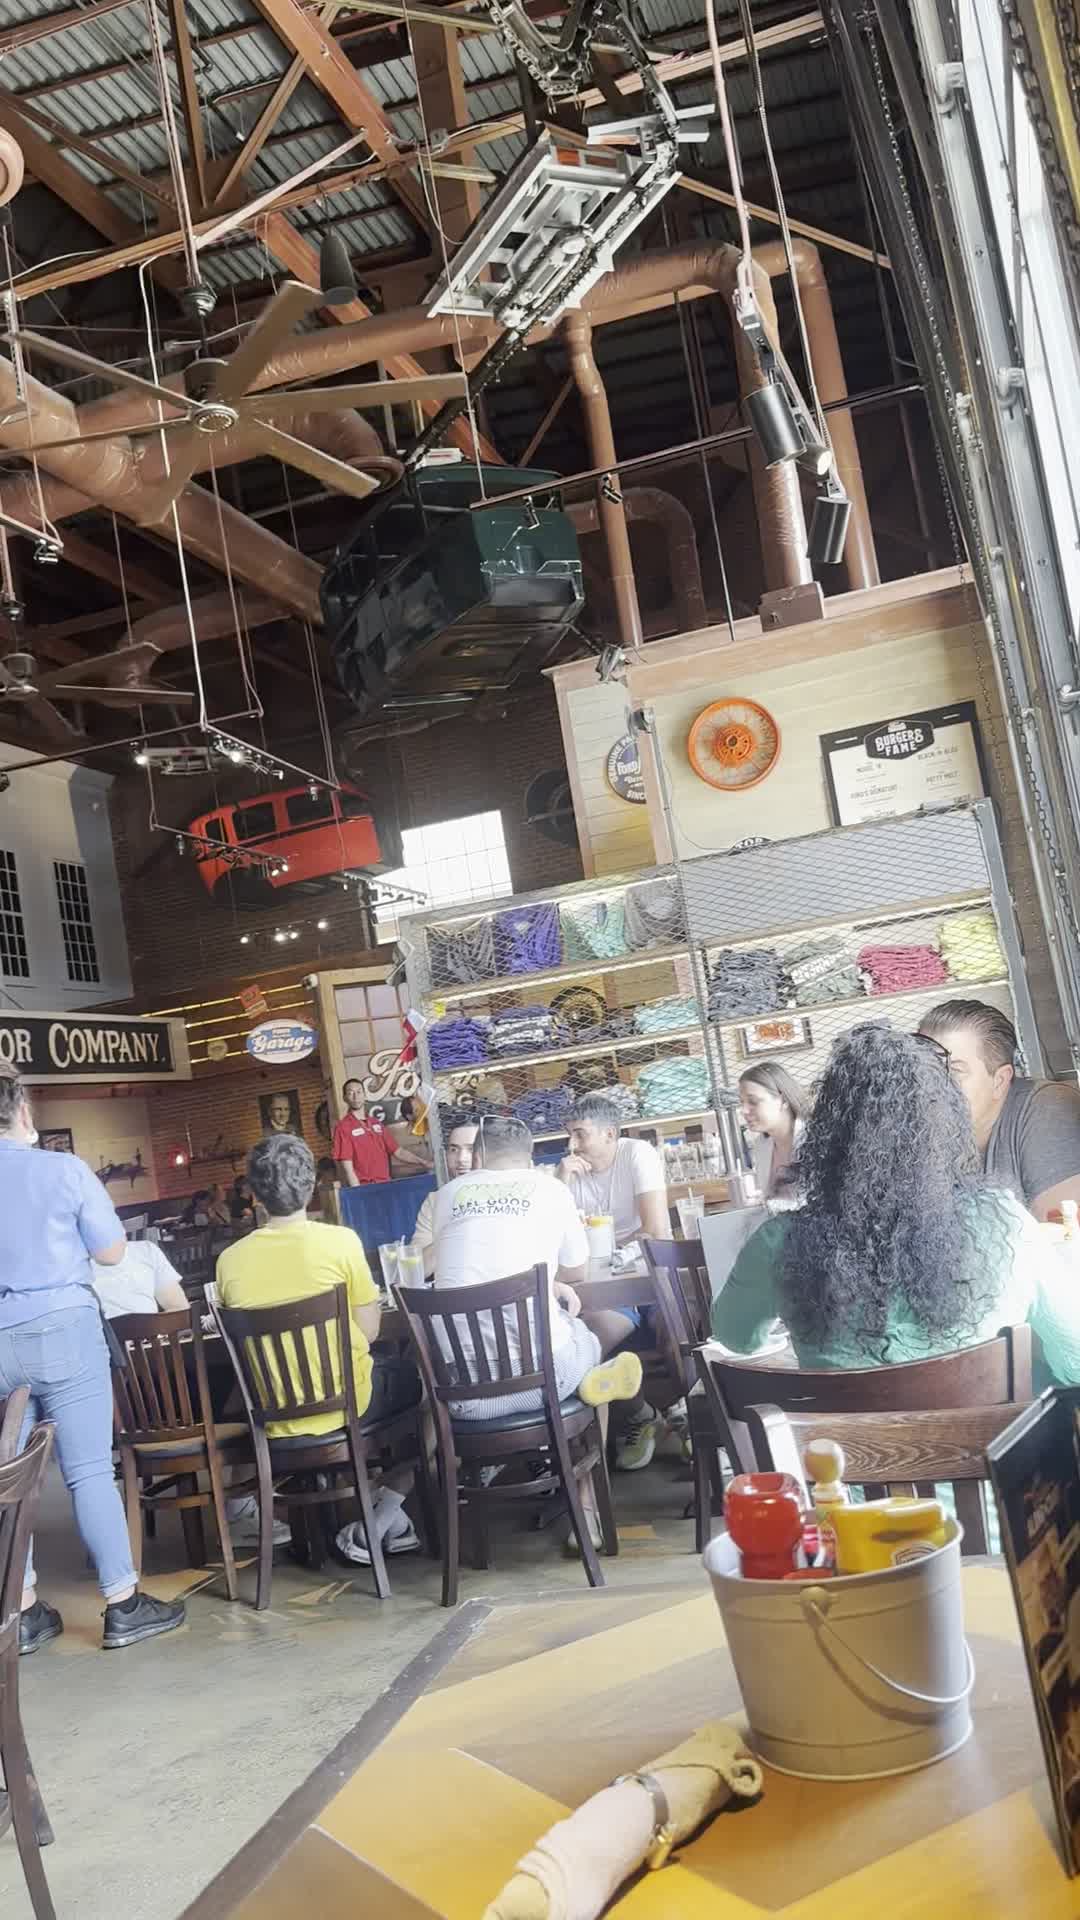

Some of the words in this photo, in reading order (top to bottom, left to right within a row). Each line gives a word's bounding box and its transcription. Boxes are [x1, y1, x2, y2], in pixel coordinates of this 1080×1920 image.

[875, 728, 924, 751] BURGERS
[885, 741, 918, 756] FAME
[48, 1022, 167, 1068] COMPANY.
[251, 1034, 313, 1054] Garage
[487, 1198, 530, 1208] GOOD
